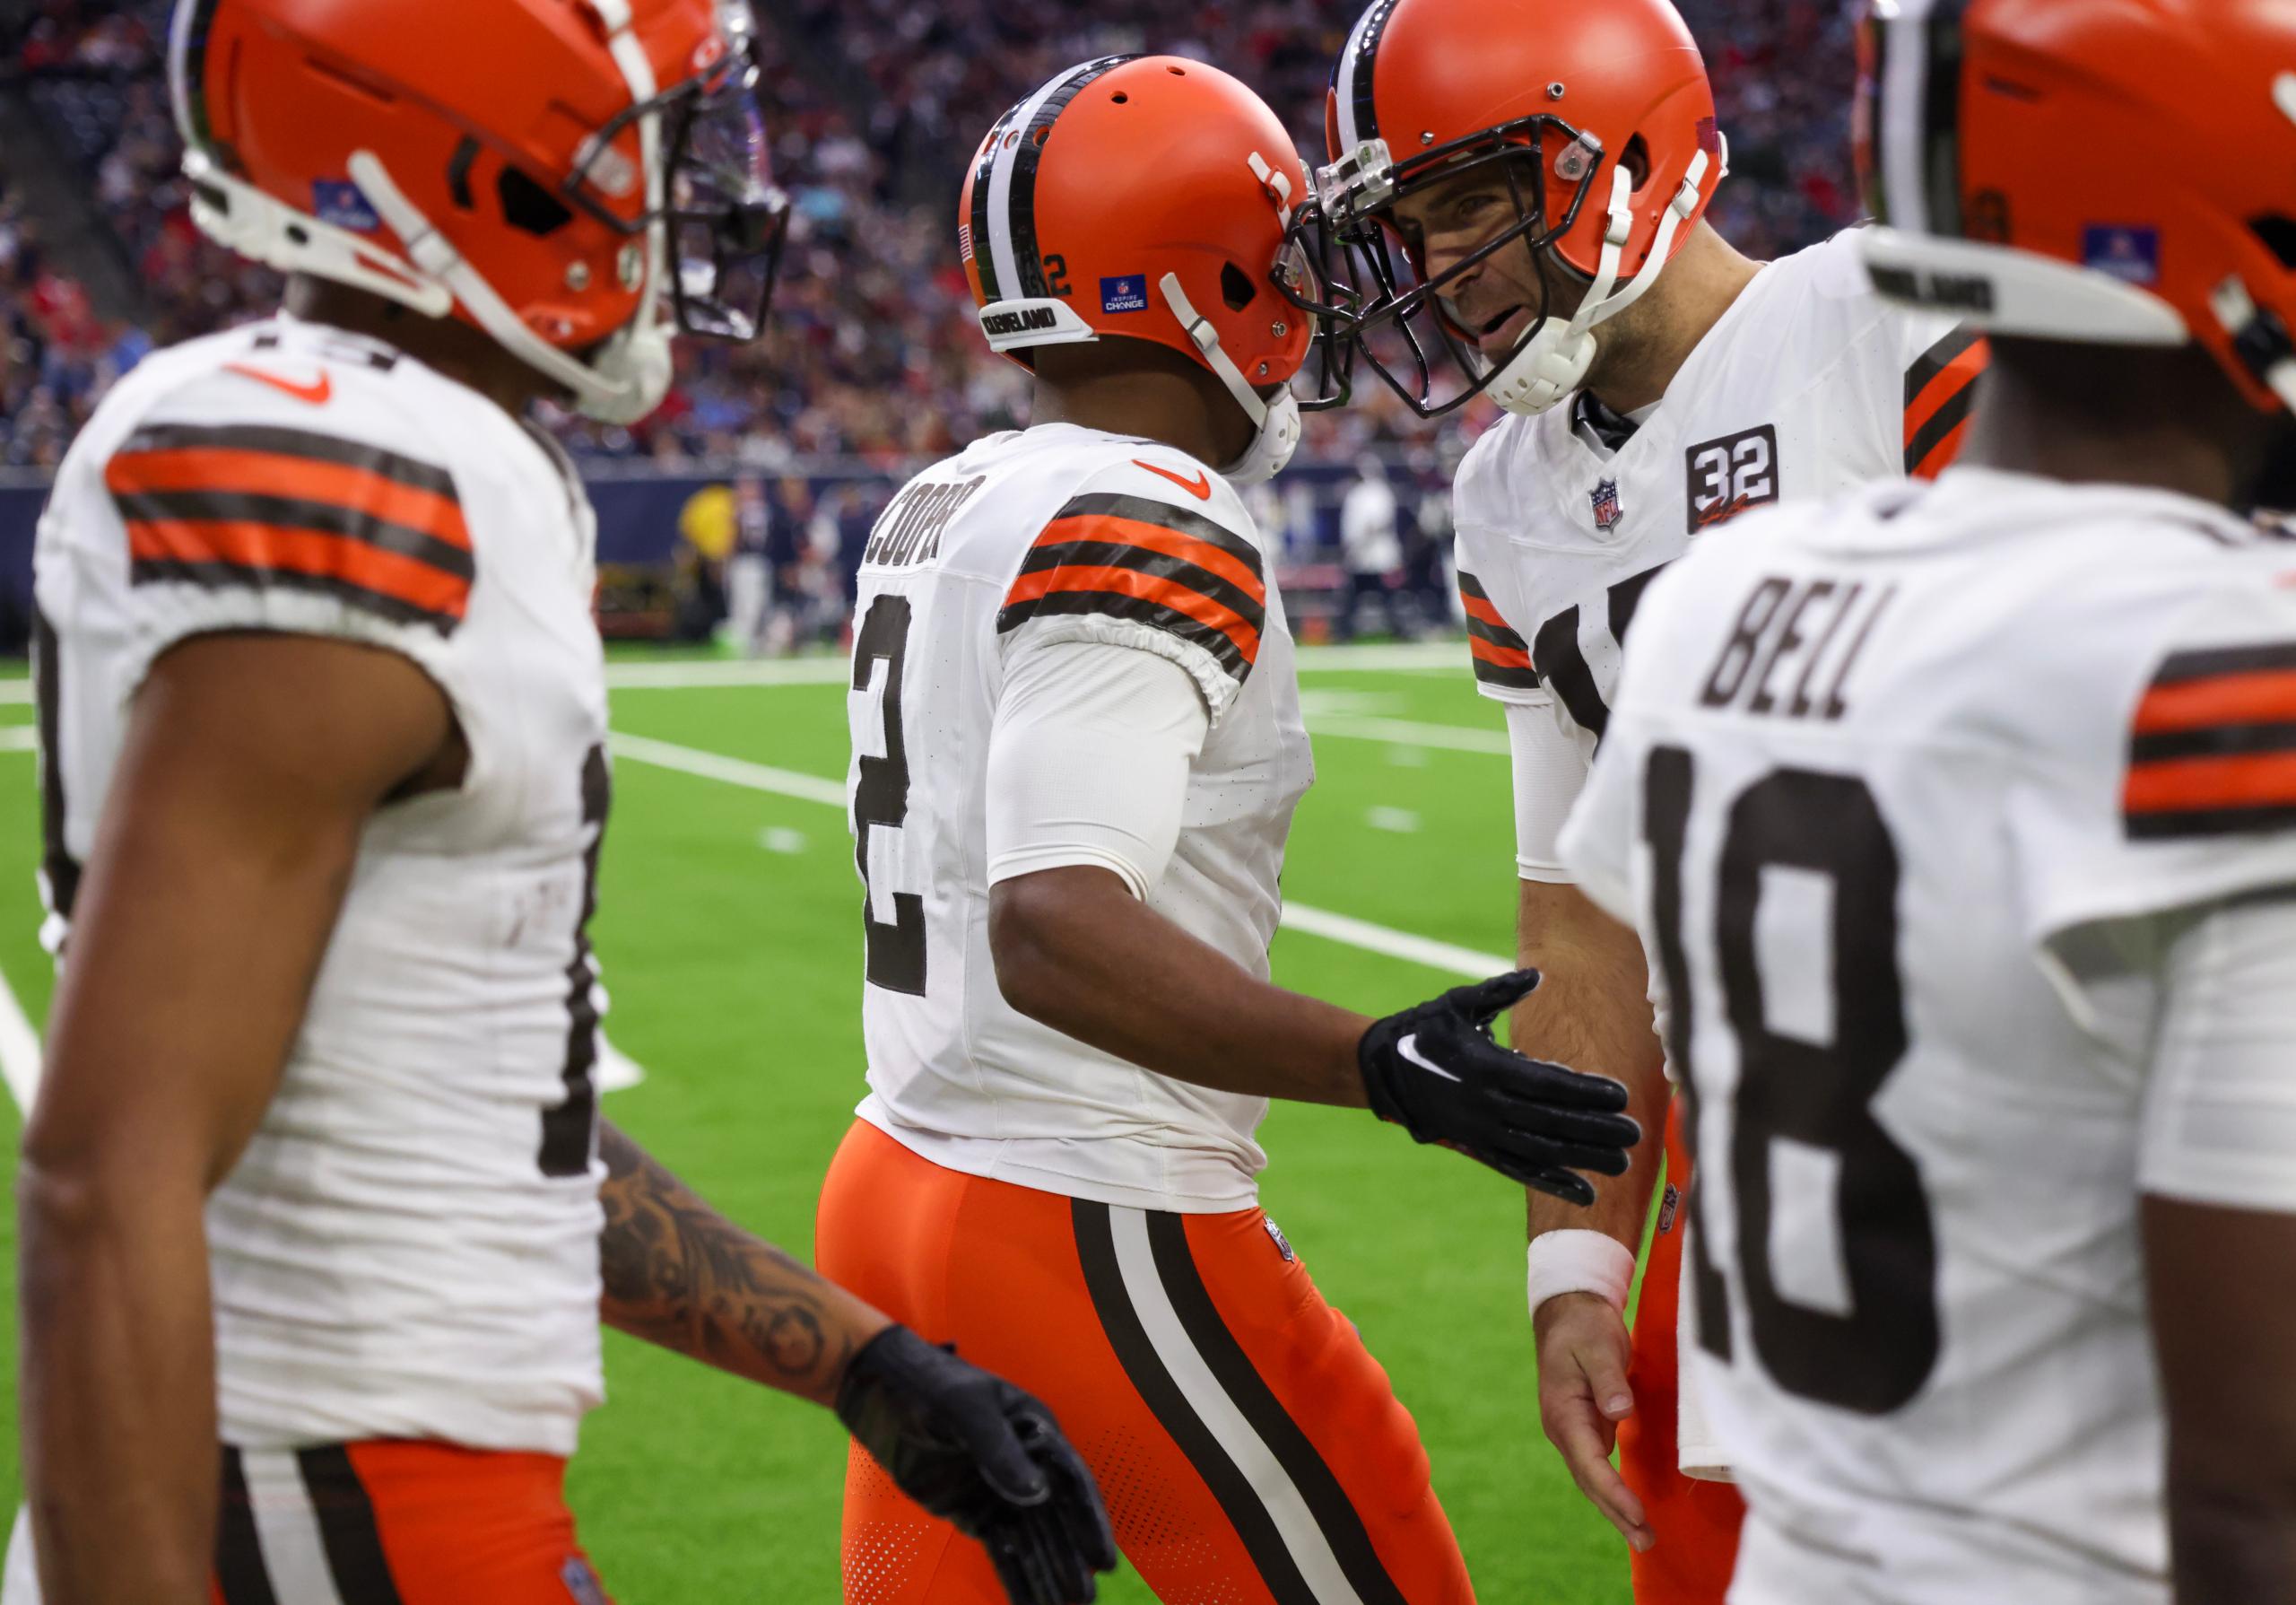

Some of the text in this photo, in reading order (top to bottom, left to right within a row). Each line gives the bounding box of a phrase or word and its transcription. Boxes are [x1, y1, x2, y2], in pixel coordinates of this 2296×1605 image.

[1043, 254, 1072, 297] 2
[1105, 300, 1144, 310] CHANGE
[1694, 436, 1771, 512] 32
[1700, 577, 1896, 720] BELL
[853, 594, 926, 998] 2
[1644, 744, 1940, 1415] 18
